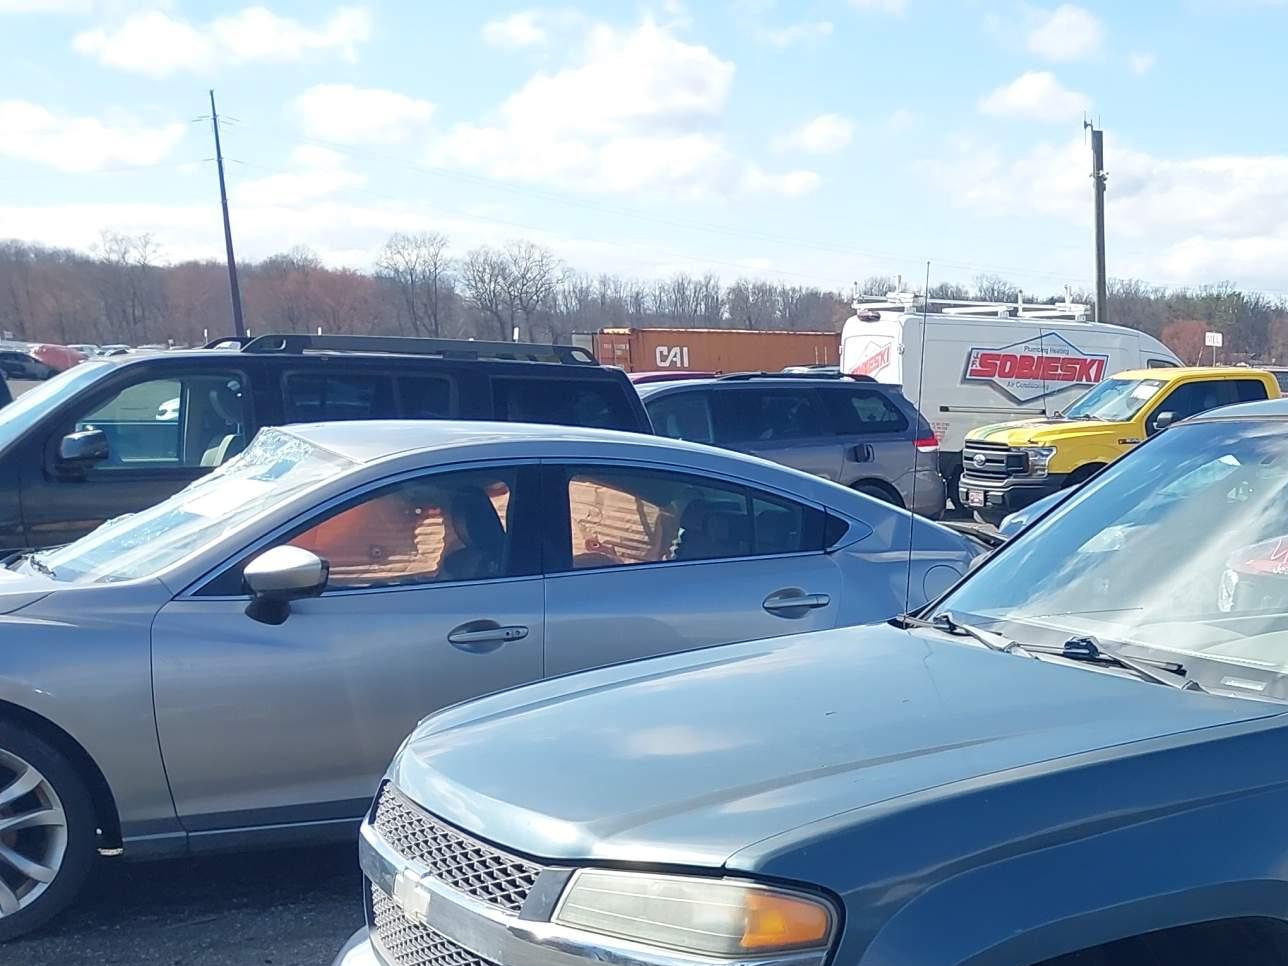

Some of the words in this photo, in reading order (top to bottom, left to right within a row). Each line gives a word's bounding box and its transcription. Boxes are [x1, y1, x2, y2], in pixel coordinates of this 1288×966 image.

[655, 345, 689, 368] CAI
[1023, 345, 1049, 355] Plumbing
[1049, 347, 1070, 356] Heating
[969, 352, 1105, 383] SOBIESKI
